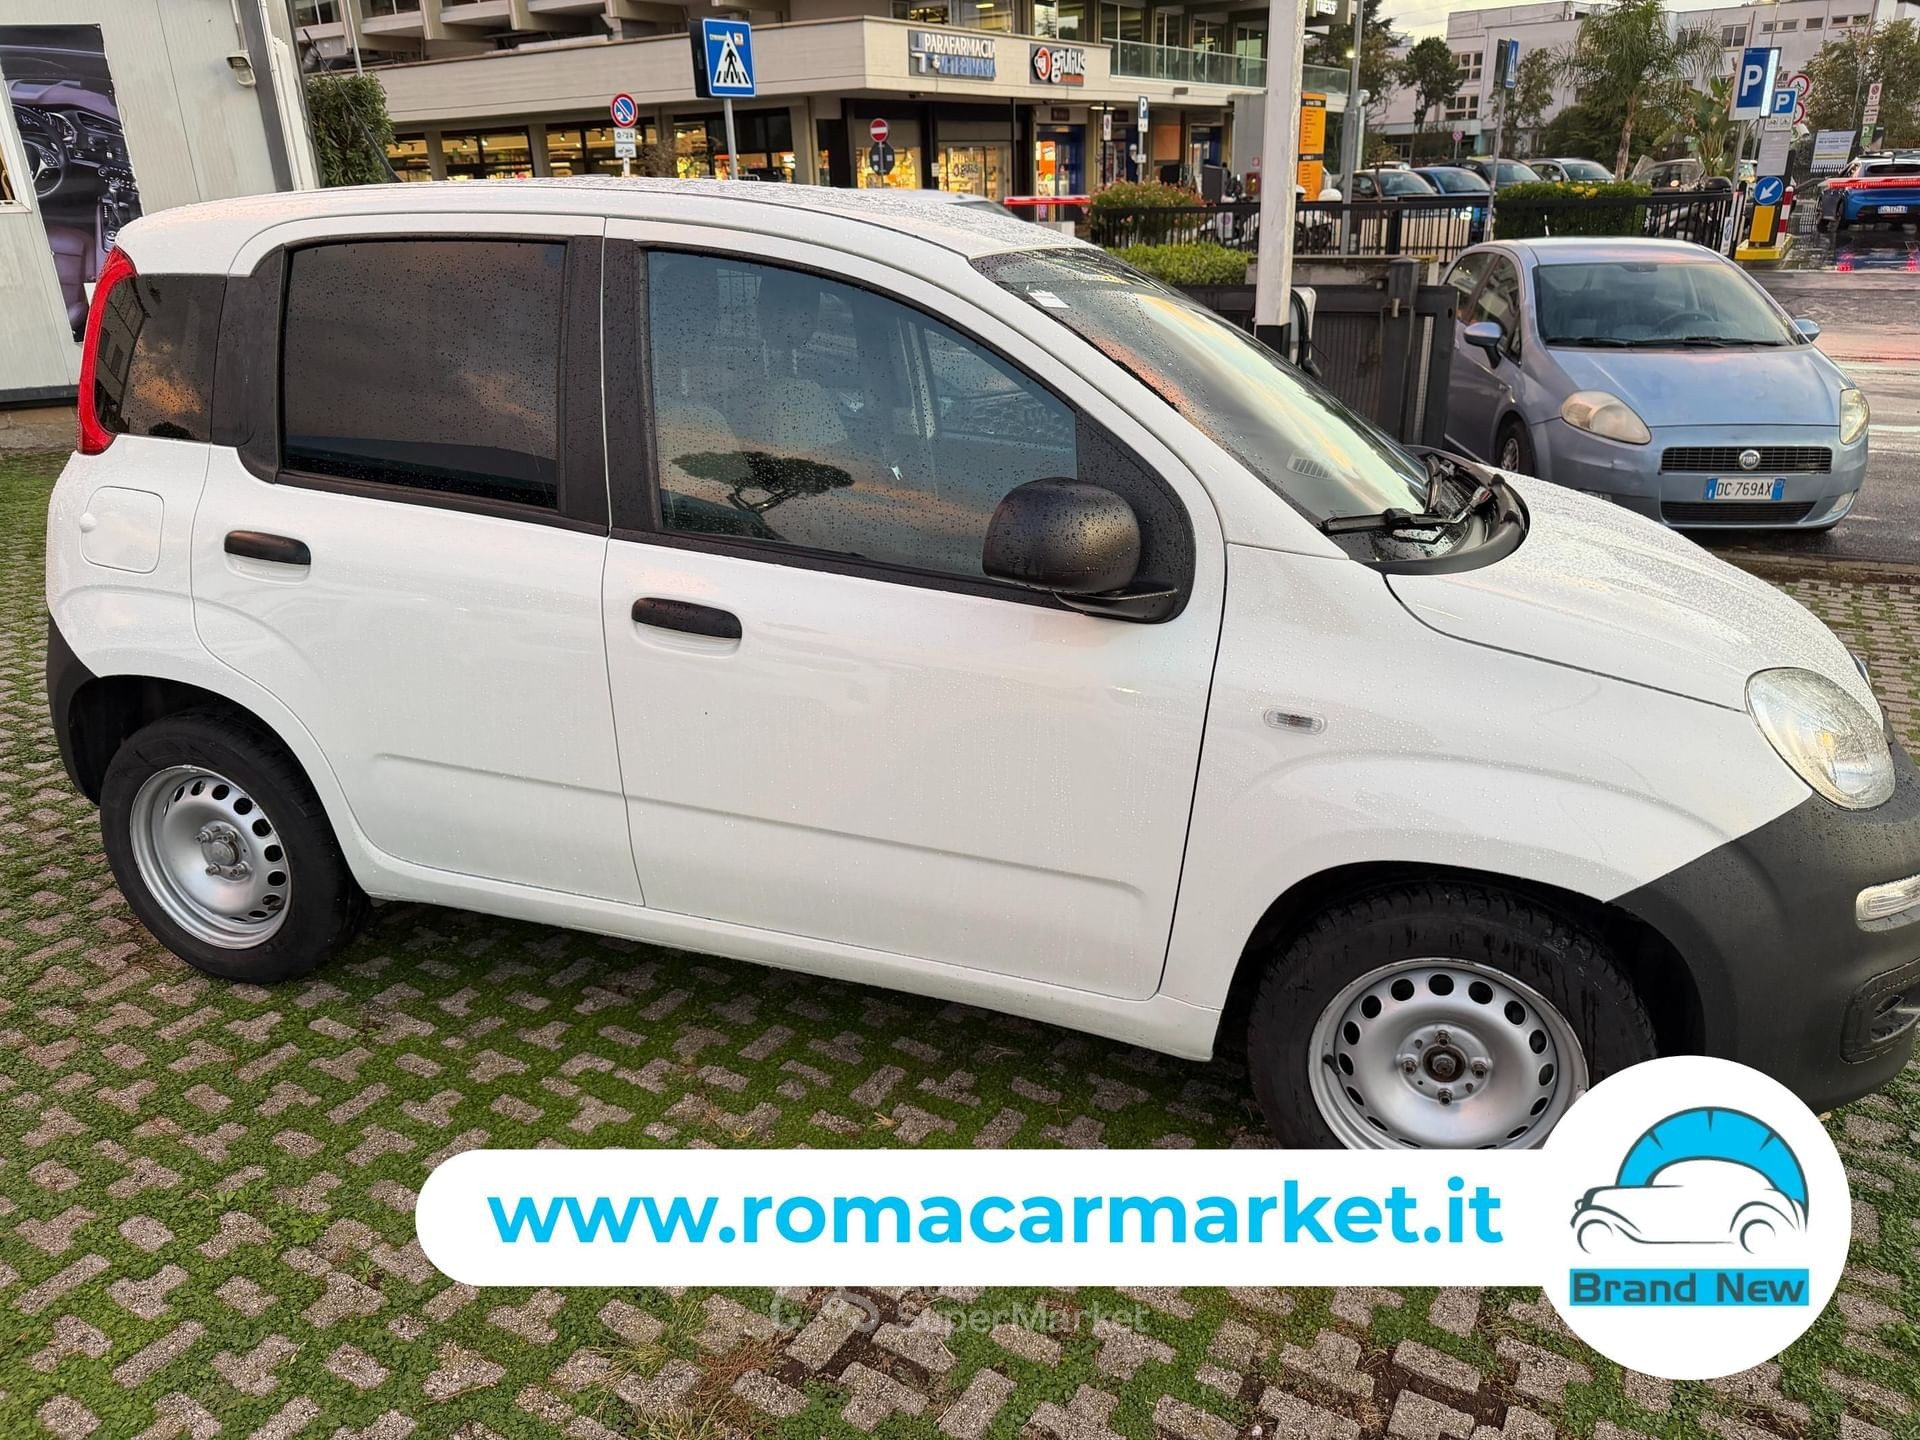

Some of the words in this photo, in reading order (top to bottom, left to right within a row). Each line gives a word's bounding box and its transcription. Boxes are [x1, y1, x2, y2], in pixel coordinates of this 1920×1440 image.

[924, 33, 996, 58] PARAFARMACIA
[1051, 48, 1086, 83] giulius
[1741, 64, 1763, 97] P
[1775, 93, 1790, 112] P
[1742, 456, 1757, 465] FIAT
